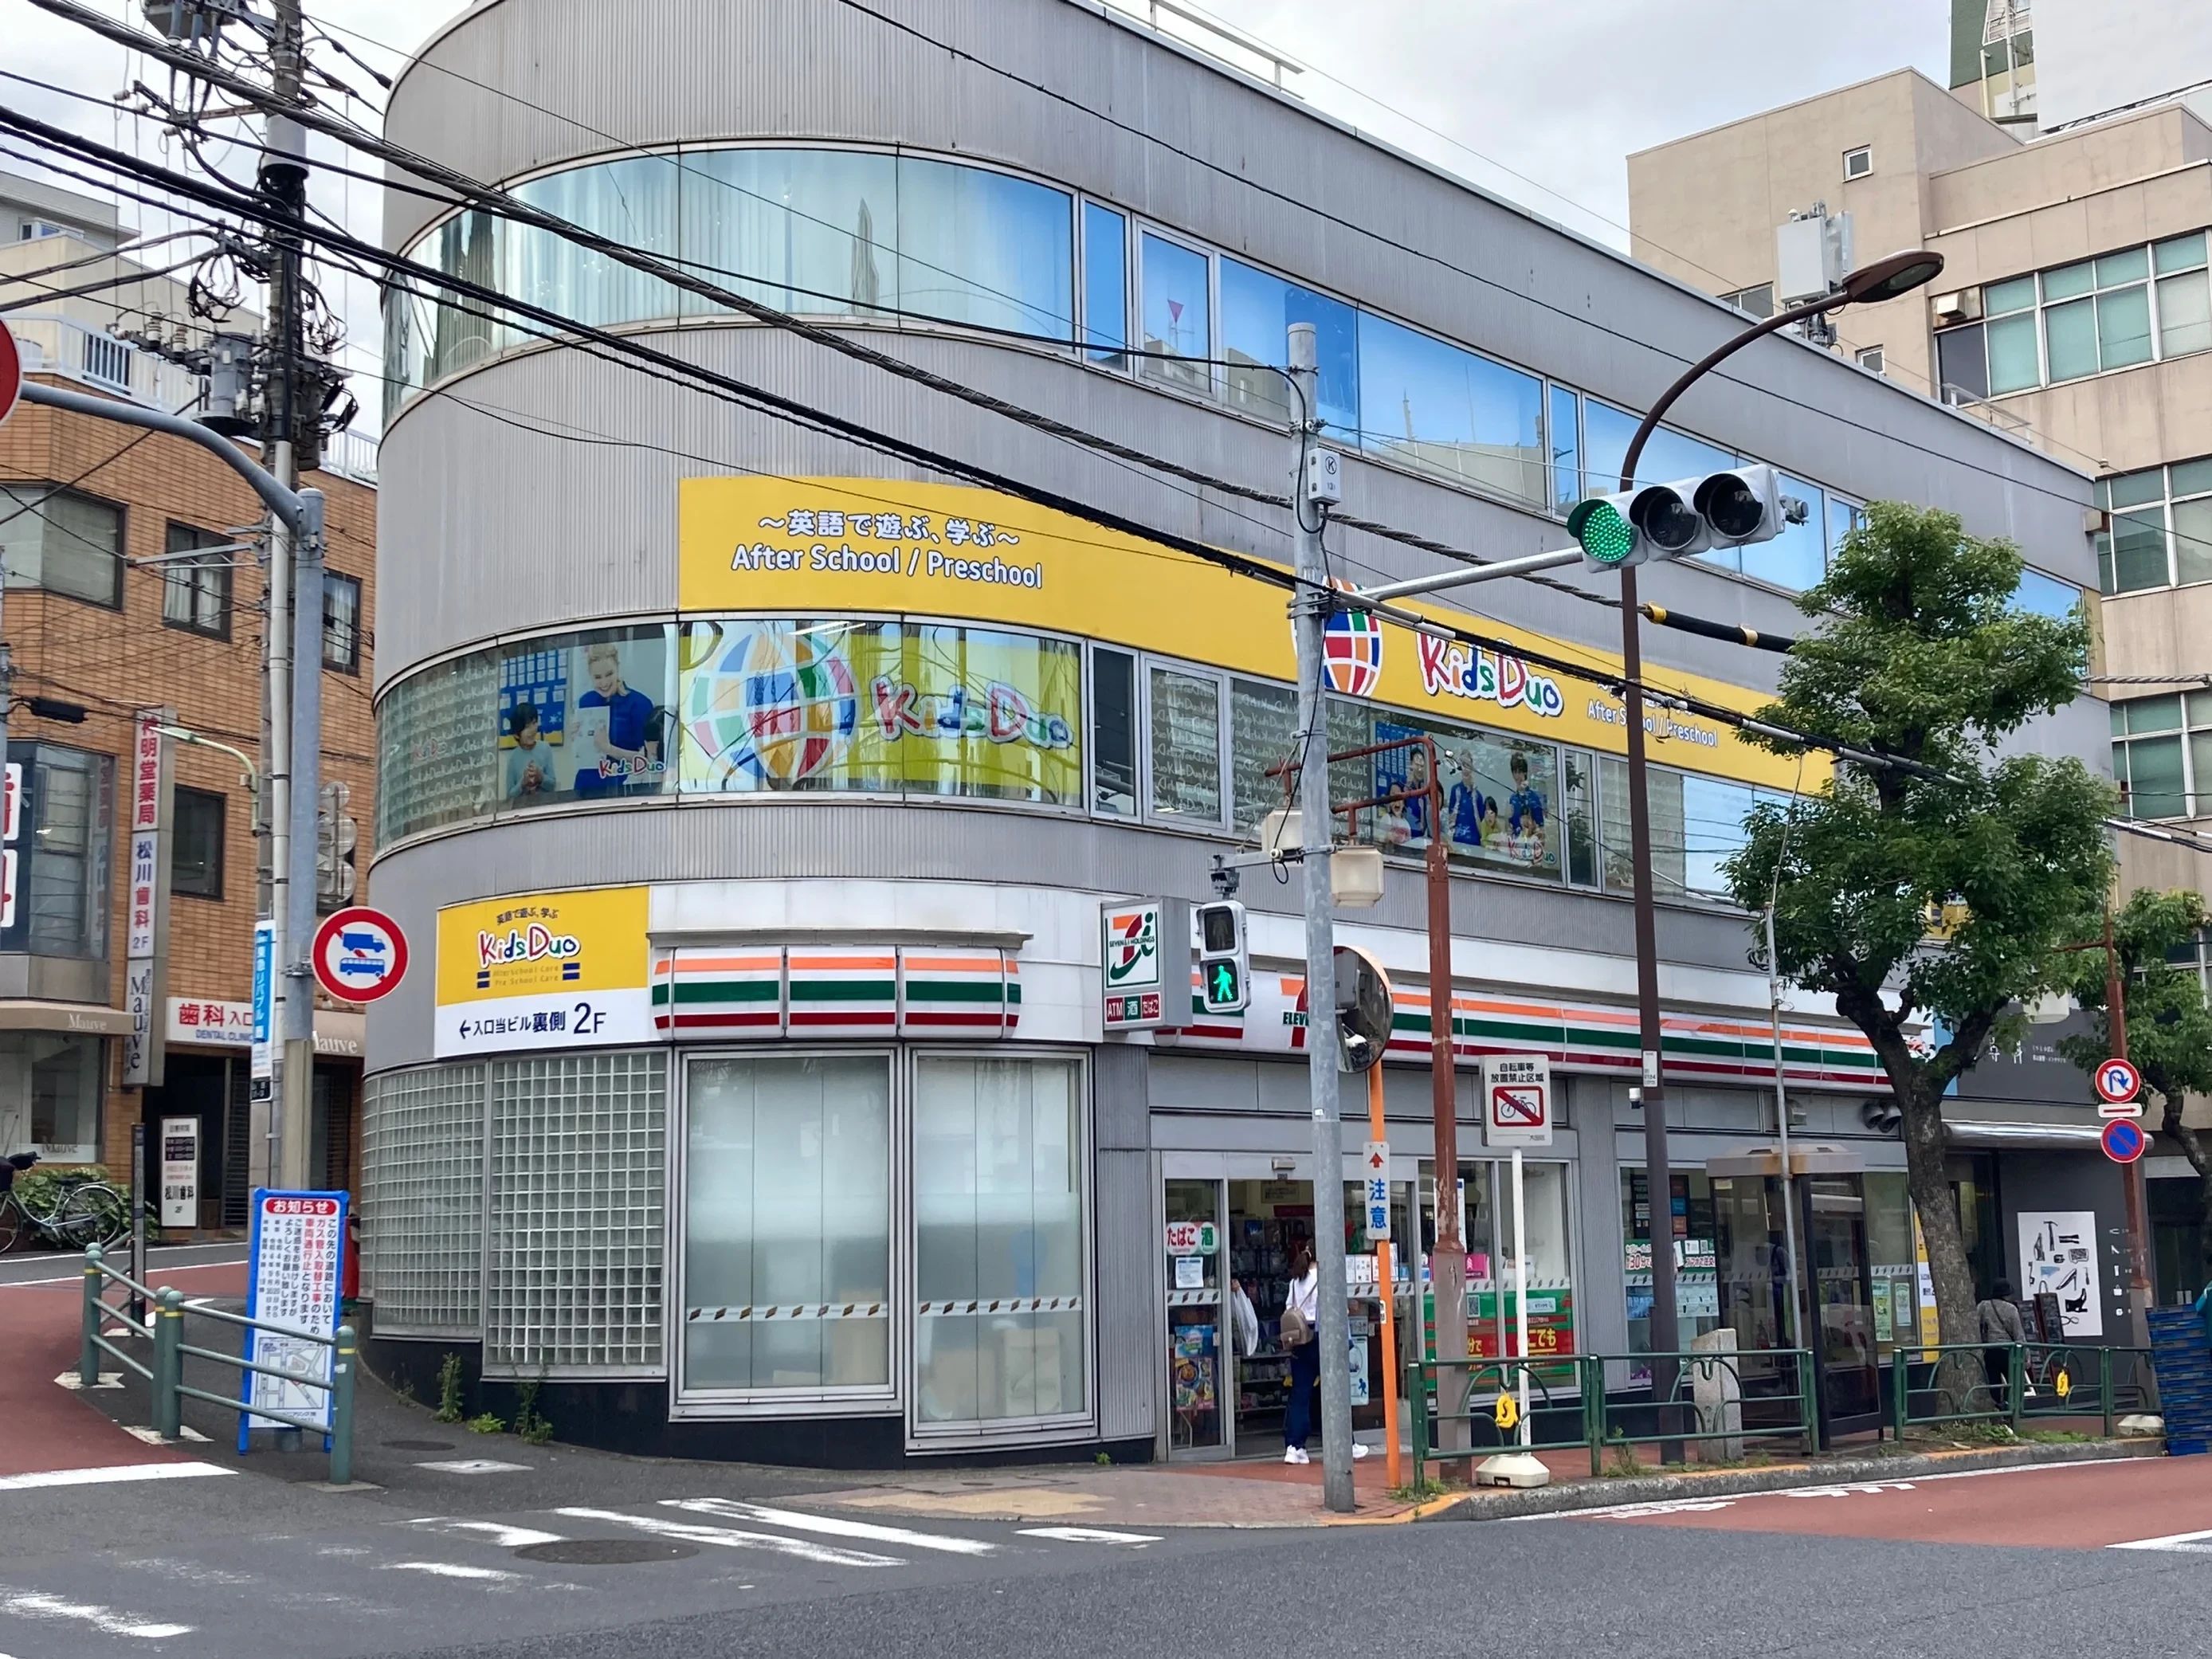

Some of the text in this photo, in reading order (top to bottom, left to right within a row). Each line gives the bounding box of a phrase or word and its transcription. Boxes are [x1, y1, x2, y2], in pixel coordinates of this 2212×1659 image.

[731, 543, 1043, 589] After School / Preschool
[1418, 633, 1563, 714] KidsDuo
[872, 679, 1073, 747] KidsDuo
[1588, 699, 1617, 724] After
[1619, 707, 1656, 735] Sol
[1667, 718, 1719, 747] Preschool
[598, 753, 665, 779] KidsDuo
[134, 841, 153, 929] 松川歯科
[496, 907, 559, 926] 英語で遊ぶ、学ぶ
[132, 936, 149, 949] 2F
[479, 923, 582, 968] KidsDuo
[1108, 1002, 1123, 1017] ATM
[1128, 1001, 1138, 1016] 酒
[1142, 999, 1159, 1014] たばこ
[68, 1012, 108, 1030] Mauve
[130, 976, 150, 1069] Mauve
[473, 1012, 566, 1036] 入口当ビル裏側
[574, 1002, 606, 1034] 2F
[1283, 1011, 1309, 1026] ELEV
[195, 1029, 226, 1040] DENTAL
[1500, 1063, 1534, 1073] 自転車等
[1491, 1073, 1544, 1083] 放置禁止区域
[273, 1200, 329, 1214] お知らせ
[1369, 1178, 1386, 1229] 注意
[1167, 1227, 1195, 1246] たばこ
[1201, 1227, 1213, 1246] 酒
